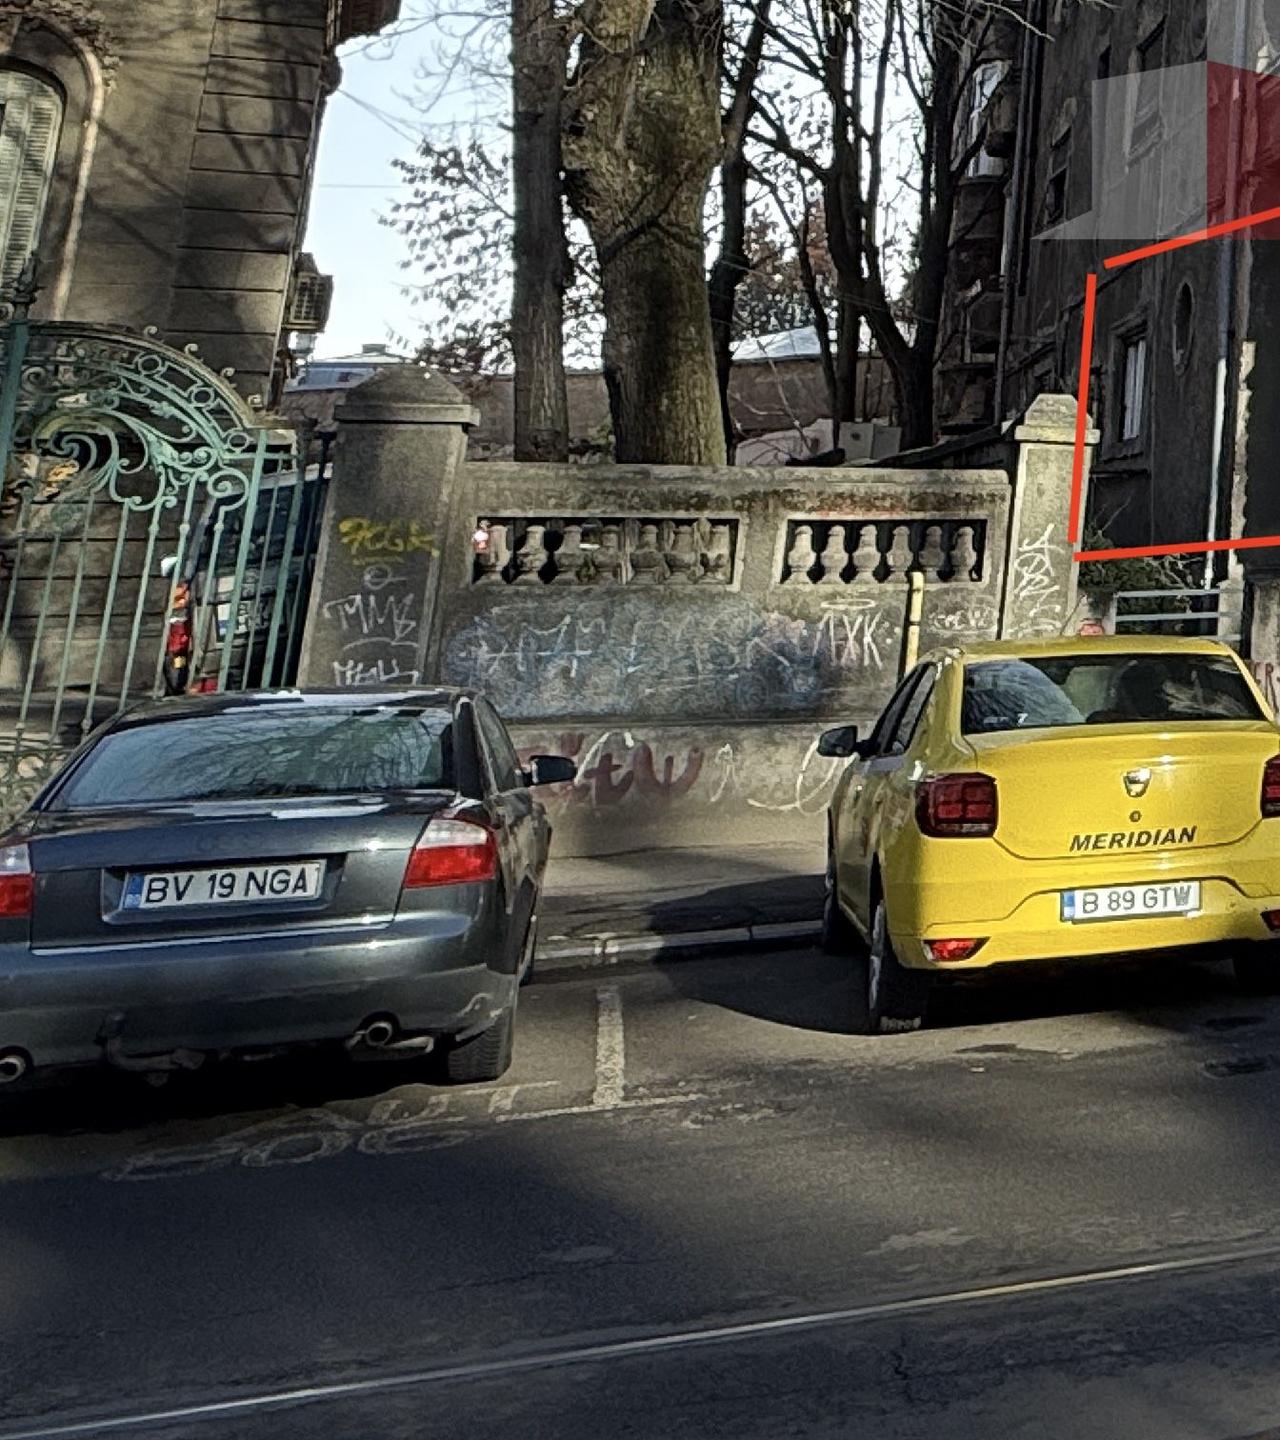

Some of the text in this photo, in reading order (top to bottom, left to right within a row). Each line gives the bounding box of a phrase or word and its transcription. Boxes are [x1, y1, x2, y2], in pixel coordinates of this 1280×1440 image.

[1069, 825, 1197, 852] MERIDIAN
[145, 867, 308, 903] BV 19 NGA
[1082, 885, 1192, 914] B 89 GTW
